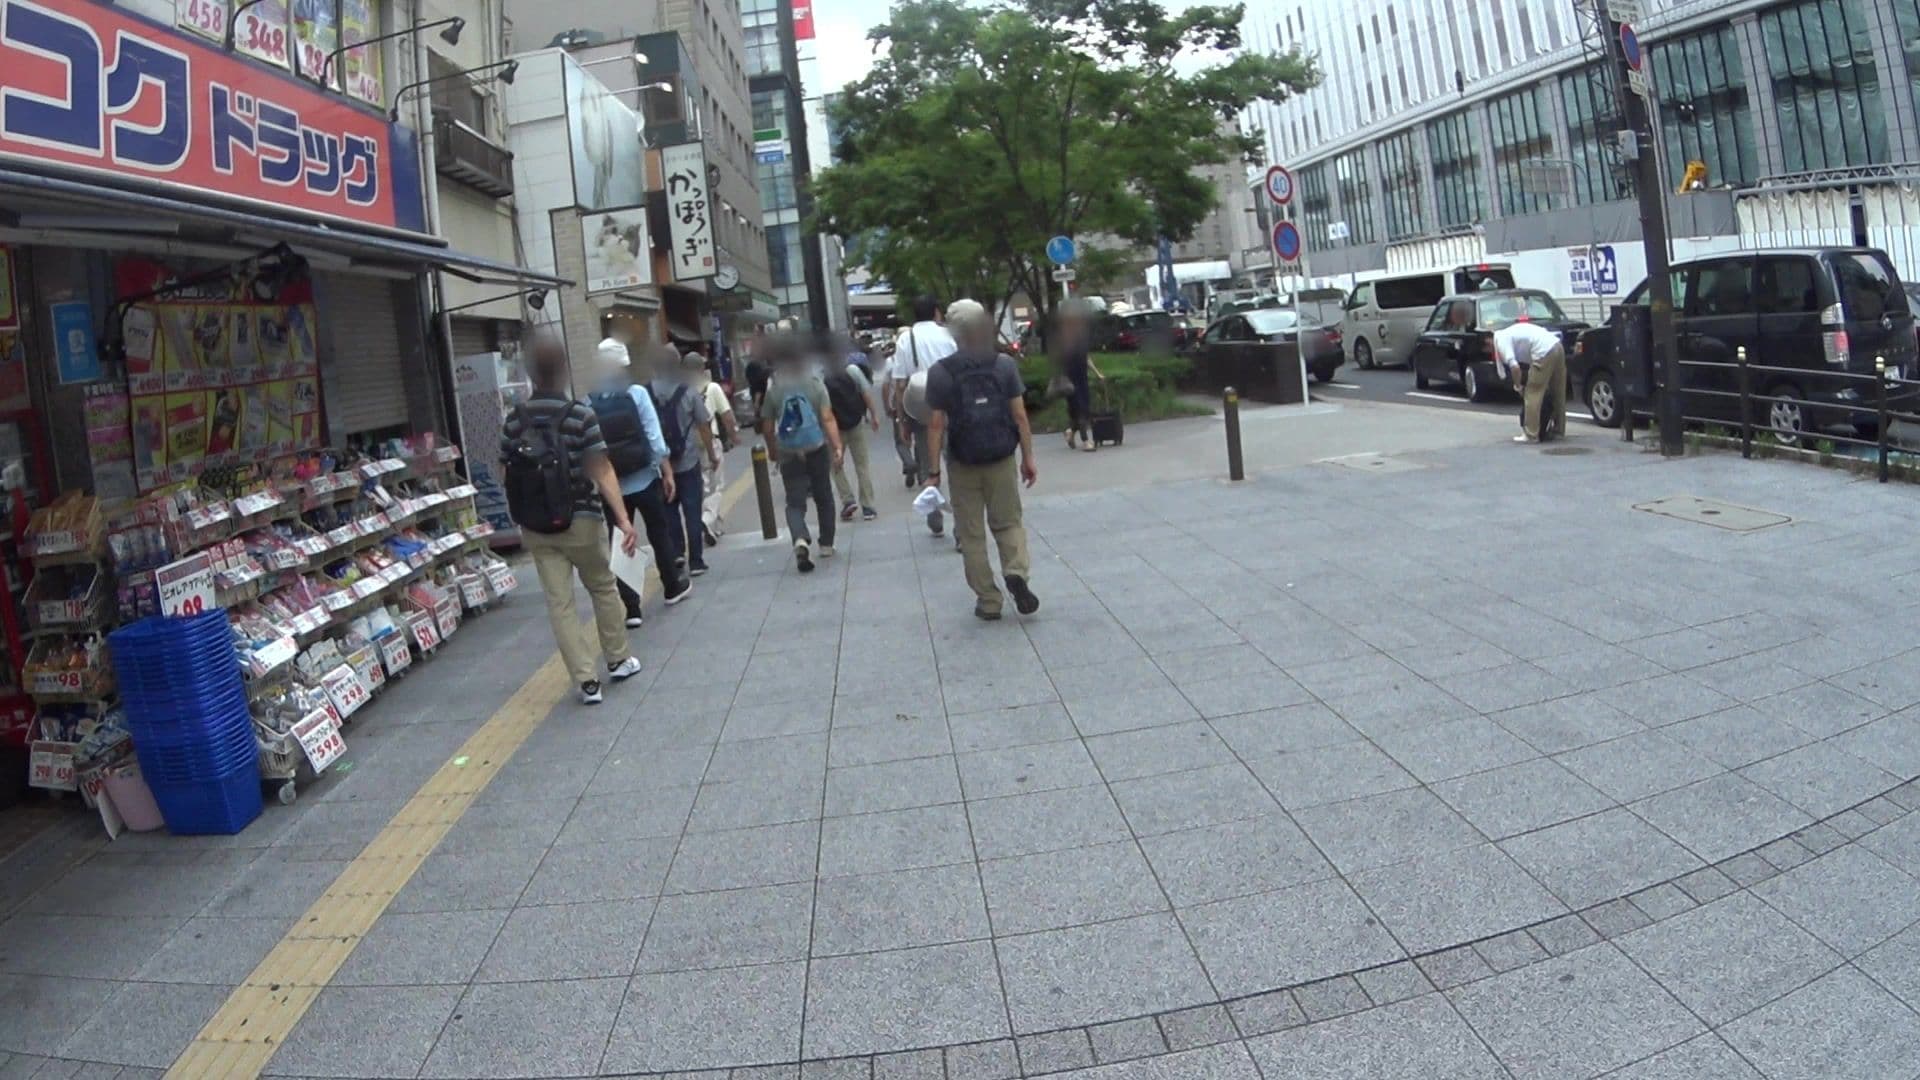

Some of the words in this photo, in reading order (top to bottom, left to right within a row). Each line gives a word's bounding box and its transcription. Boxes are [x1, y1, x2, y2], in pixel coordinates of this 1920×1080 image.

[246, 15, 285, 62] 348
[1273, 175, 1288, 194] 40
[668, 168, 707, 266] かっぽうぎ
[58, 672, 80, 688] 98
[342, 685, 364, 706] 298
[316, 734, 340, 760] 598
